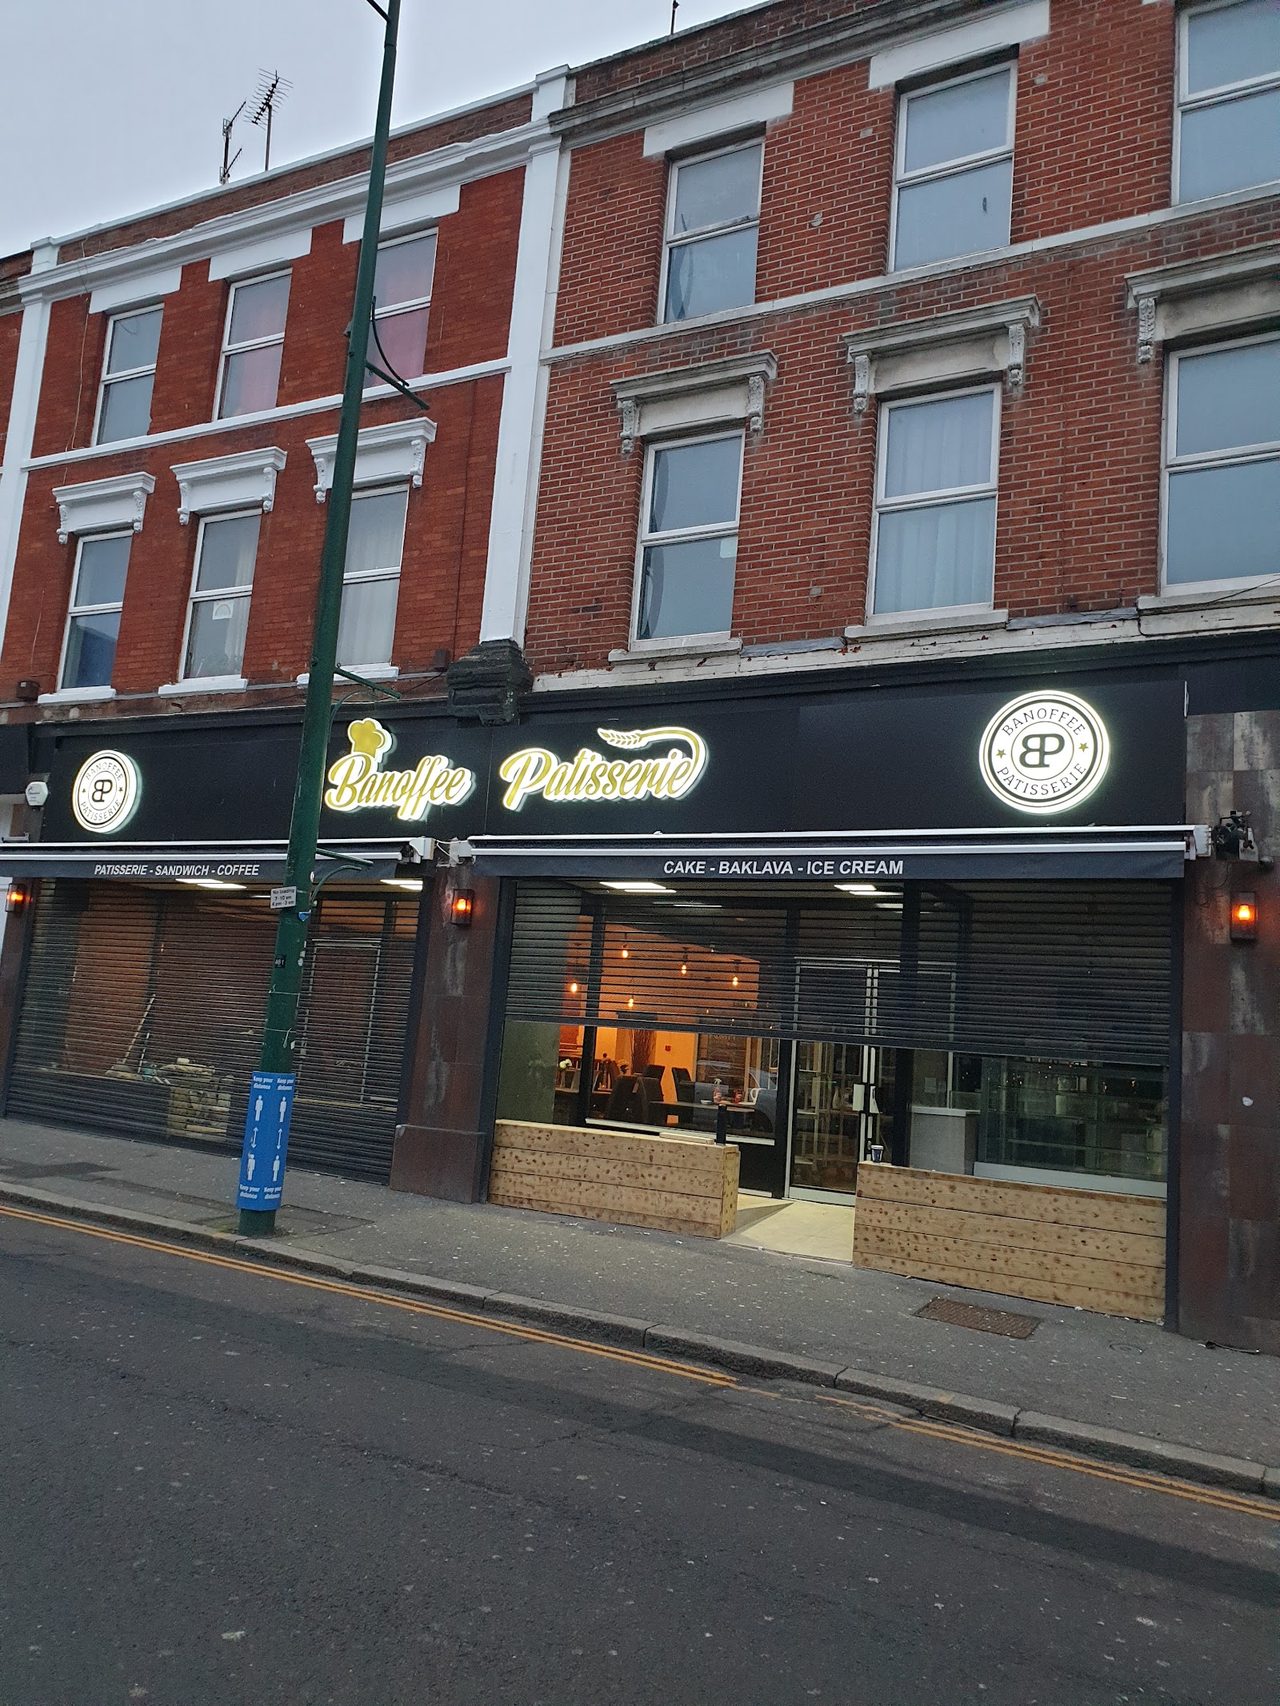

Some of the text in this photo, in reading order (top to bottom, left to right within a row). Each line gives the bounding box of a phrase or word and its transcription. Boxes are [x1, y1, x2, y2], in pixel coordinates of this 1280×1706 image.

[1002, 707, 1086, 737] BANOFFEE
[85, 761, 124, 781] BANOFFEE
[325, 744, 700, 820] Banoffee Patisserie
[996, 762, 1087, 796] PATISSERIE
[80, 799, 121, 821] PATISSERIE
[94, 864, 148, 876] PATISSERIE
[155, 864, 209, 876] SANDWICH
[216, 864, 260, 876] COFFEE
[663, 861, 706, 875] CAKE
[718, 860, 794, 875] BAKLAVA
[806, 860, 834, 875] ICE
[839, 860, 904, 875] CREAM
